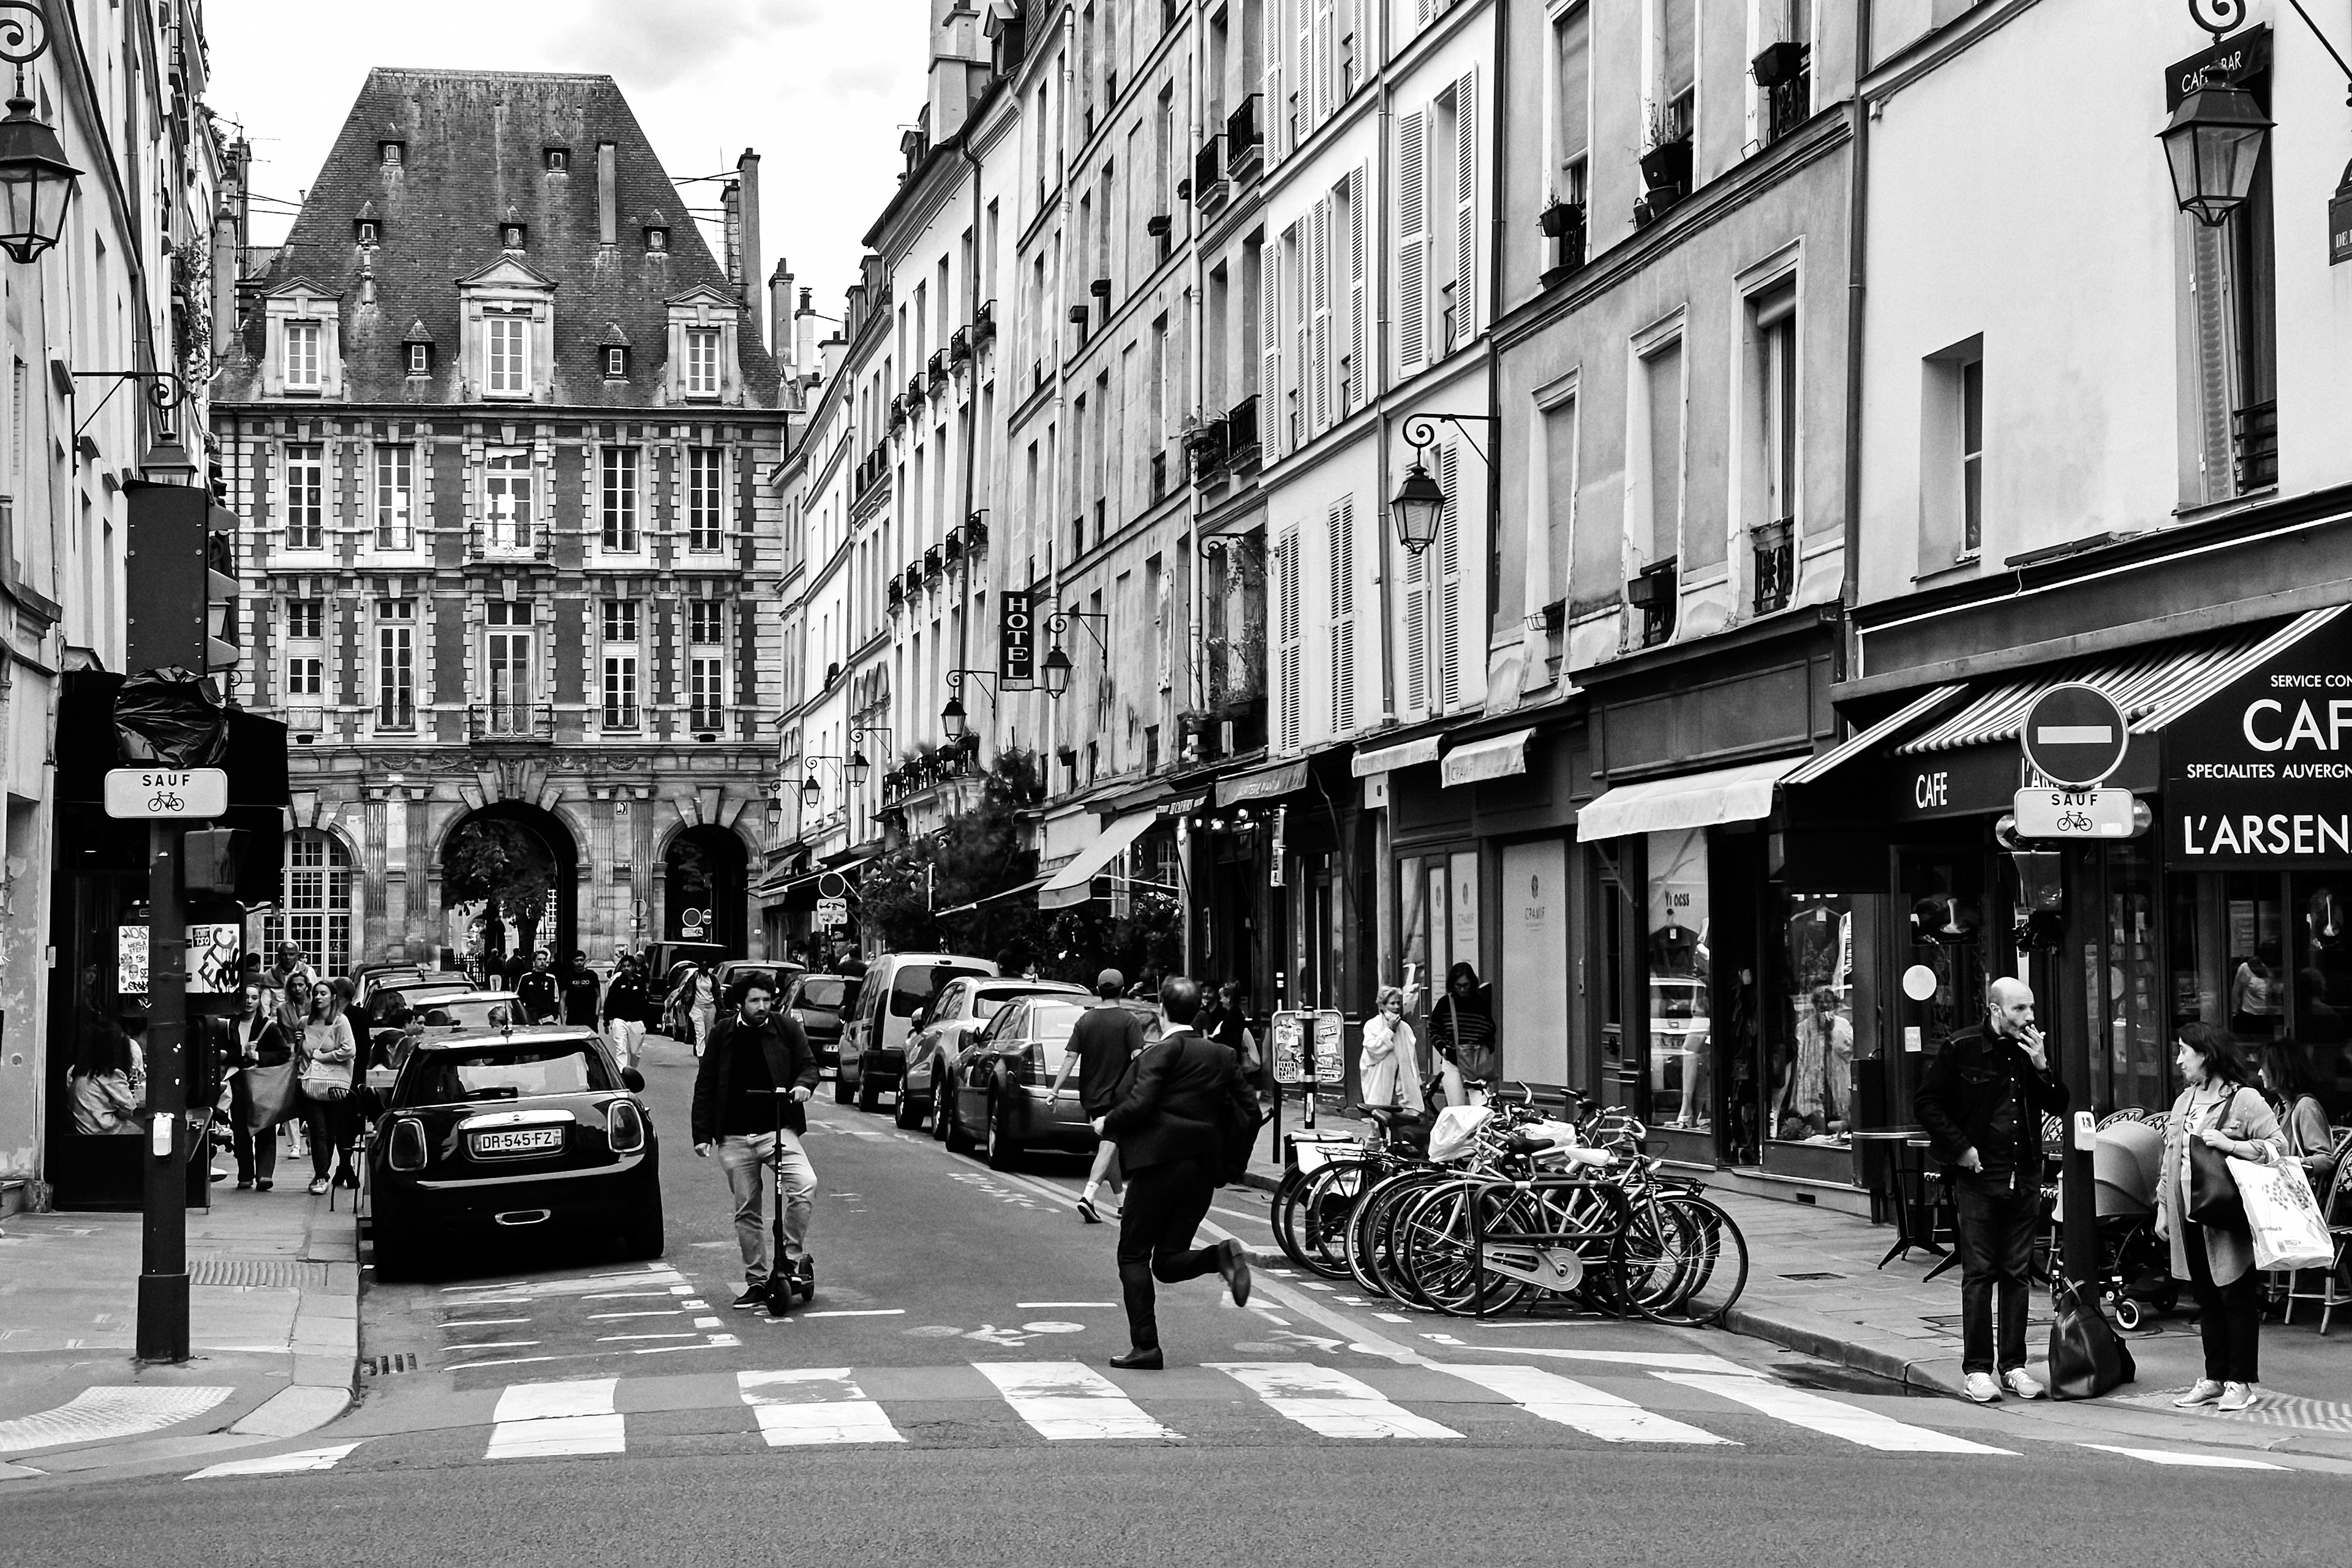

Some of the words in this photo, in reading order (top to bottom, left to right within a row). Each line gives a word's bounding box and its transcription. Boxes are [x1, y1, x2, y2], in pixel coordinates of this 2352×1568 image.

[2221, 51, 2242, 70] BAR
[2335, 231, 2348, 248] DE
[1007, 597, 1028, 677] HOTEL
[2271, 675, 2321, 687] SERVICE
[2243, 698, 2352, 752] CAF
[2187, 764, 2275, 778] SPECIALITES
[143, 774, 190, 786] SAUF
[1915, 772, 1948, 809] CAFE
[2051, 794, 2098, 806] SAUF
[2184, 813, 2352, 854] L'ARSEN
[483, 1132, 552, 1148] DR-545-FZ
